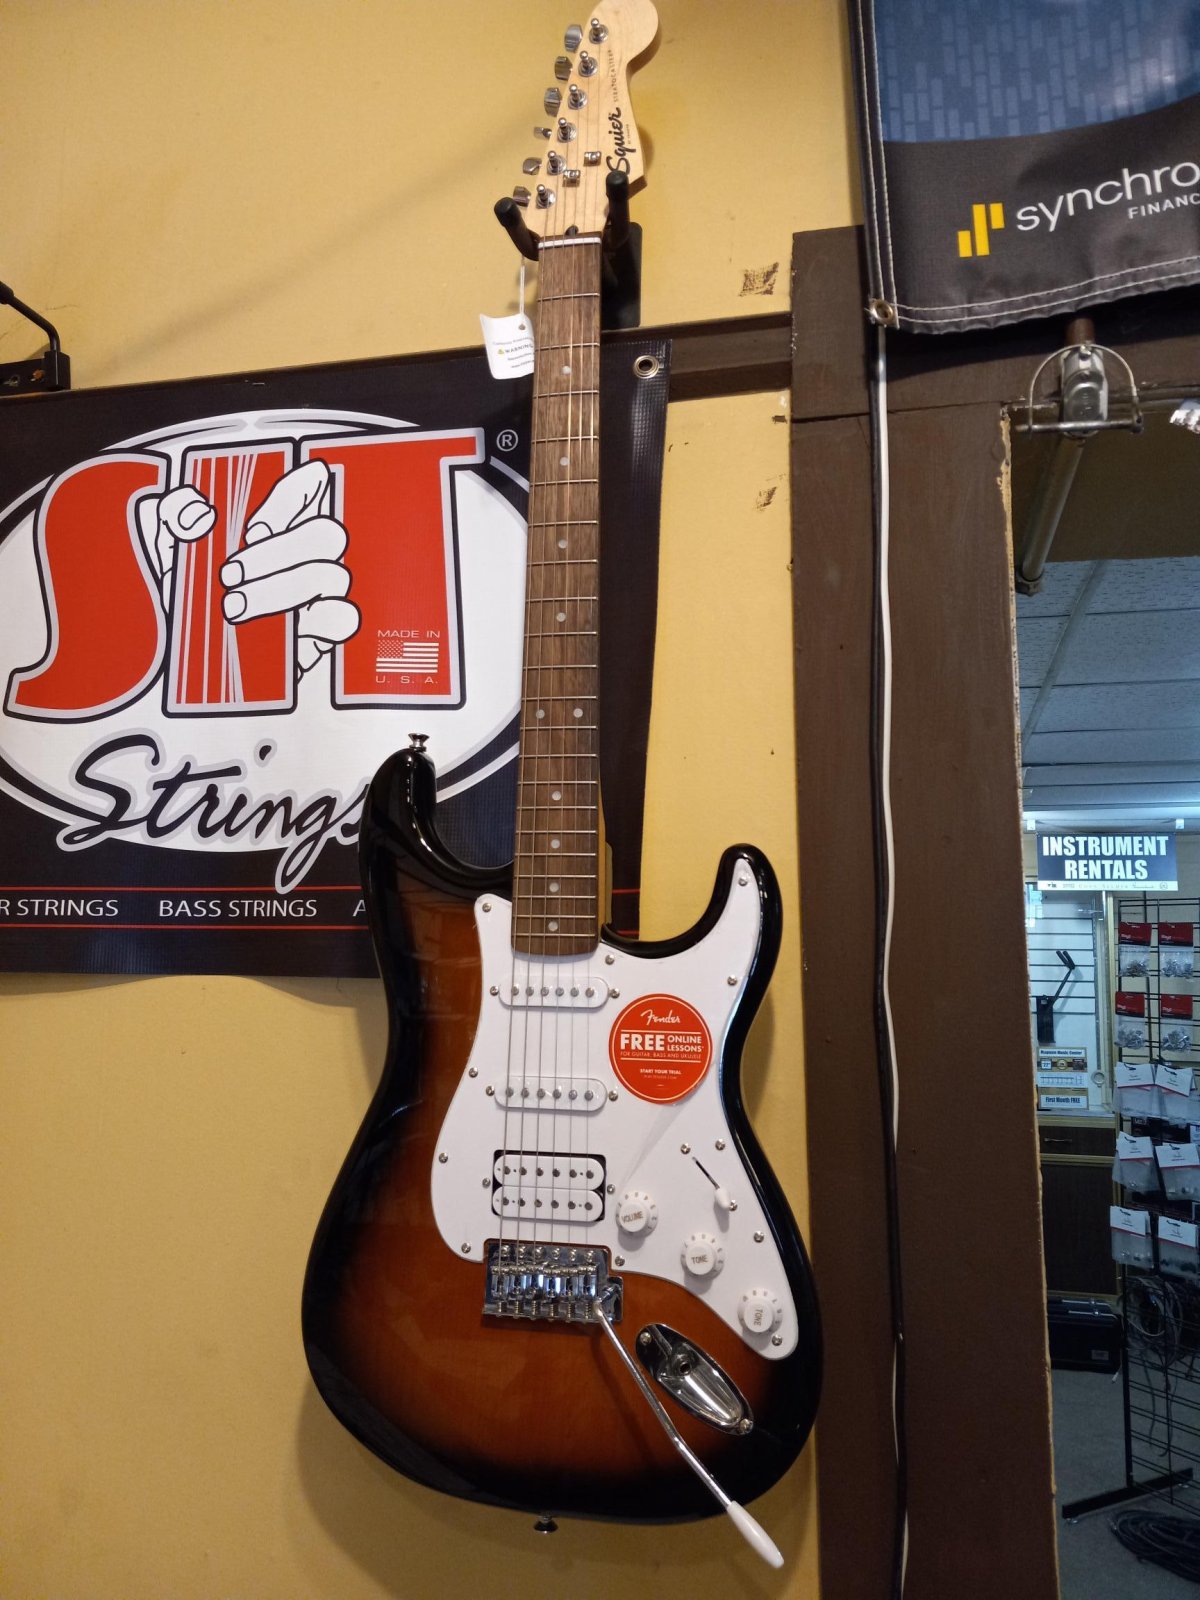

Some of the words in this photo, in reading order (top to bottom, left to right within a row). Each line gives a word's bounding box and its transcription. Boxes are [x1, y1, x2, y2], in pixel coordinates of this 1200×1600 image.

[606, 107, 636, 175] Squier
[1016, 161, 1200, 232] synchro
[377, 629, 420, 638] MADE
[426, 630, 440, 638] IN
[1042, 836, 1169, 856] INSTRUMENT
[1064, 859, 1148, 880] RENTALS
[17, 899, 119, 917] STRINGS
[159, 899, 222, 917] BASS
[228, 899, 317, 918] STRINGS
[640, 1009, 680, 1026] Fender
[620, 1033, 665, 1051] FREE
[667, 1035, 702, 1044] ONLINE
[621, 1211, 643, 1224] VOLUME
[691, 1254, 708, 1265] TONE
[754, 1309, 763, 1326] TONE
